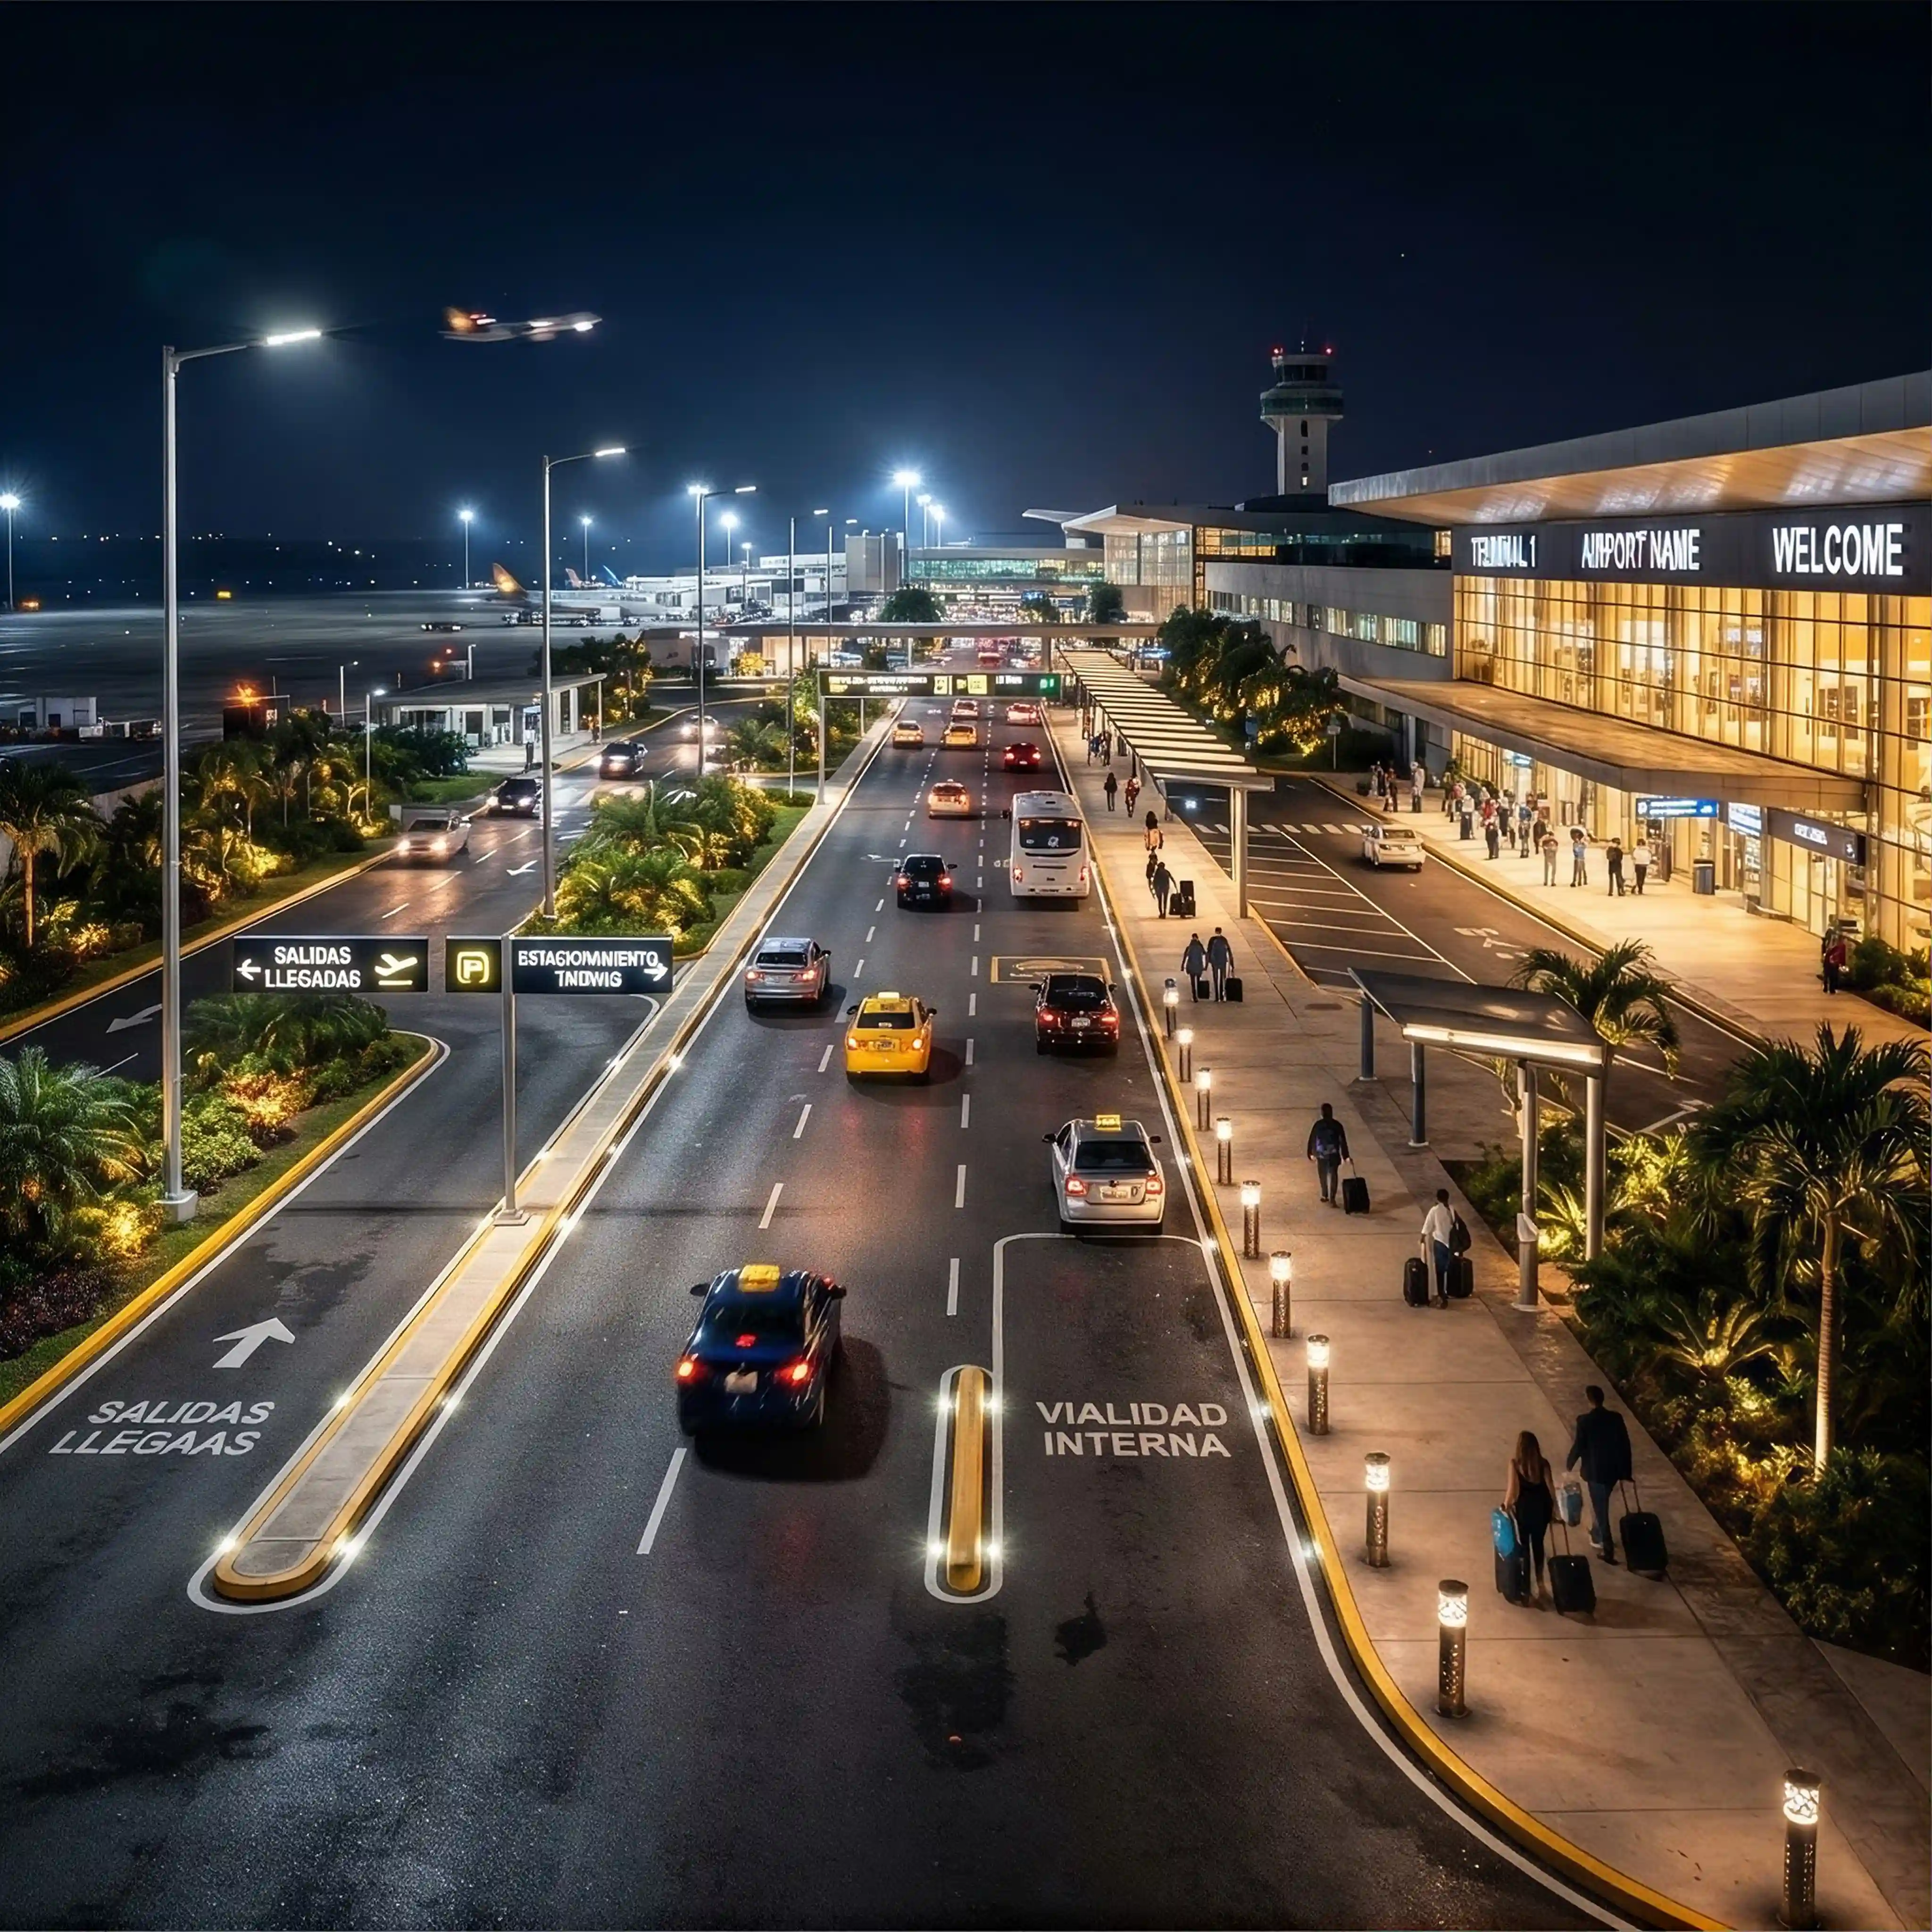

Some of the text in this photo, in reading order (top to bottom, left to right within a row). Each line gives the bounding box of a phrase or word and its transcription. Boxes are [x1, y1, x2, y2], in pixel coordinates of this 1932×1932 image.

[1773, 524, 1903, 575] WELCOME
[274, 946, 351, 965] SALIDAS
[88, 1400, 275, 1424] SALIDAS
[1036, 1401, 1228, 1426] VIALIDAD
[48, 1430, 261, 1456] LLEGAAS
[1044, 1432, 1232, 1457] INTERNA
